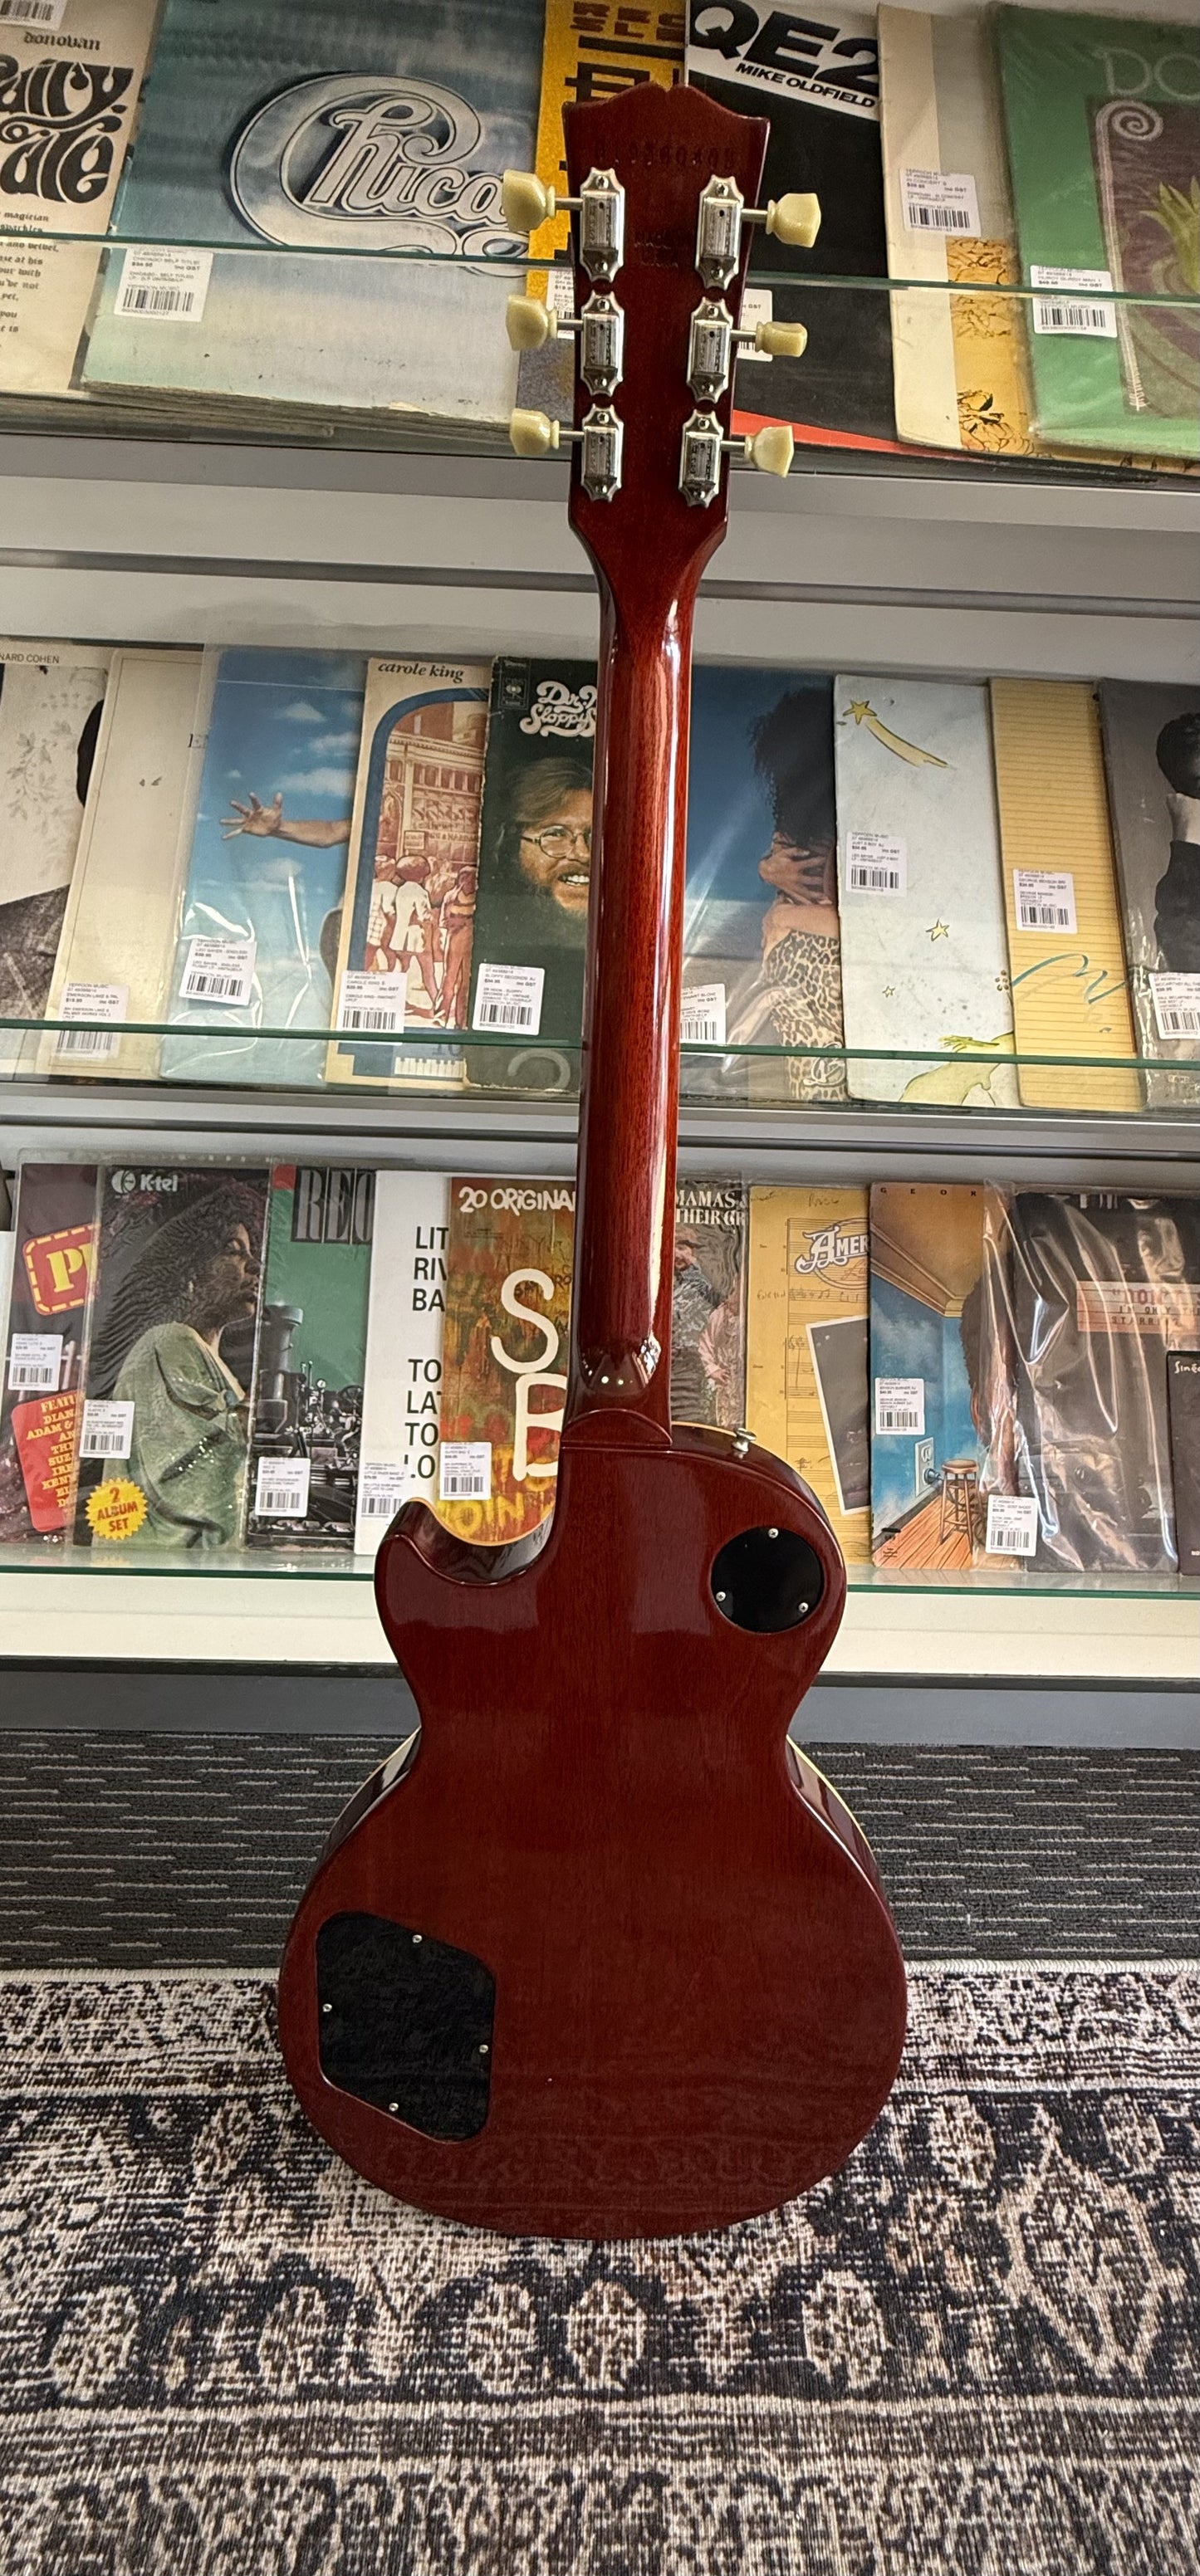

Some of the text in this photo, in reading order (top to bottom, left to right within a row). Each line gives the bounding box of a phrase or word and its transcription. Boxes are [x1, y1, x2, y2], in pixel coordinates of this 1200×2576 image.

[24, 32, 100, 51] donovan
[688, 0, 879, 98] QE2
[736, 62, 875, 109] MIKE OLDFIELD
[27, 653, 60, 663] COHEN
[378, 662, 465, 684] carole king
[140, 1172, 179, 1193] K-tel
[459, 1186, 487, 1213] 20
[415, 1226, 449, 1250] LIT
[412, 1288, 445, 1312] BA
[491, 1268, 560, 1374] S
[408, 1358, 443, 1383] TO
[406, 1390, 442, 1415] LA
[27, 1422, 62, 1440] ADAM
[64, 1420, 74, 1430] &
[404, 1421, 438, 1446] TO
[110, 1486, 120, 1504] 2
[97, 1500, 138, 1521] ALBUM
[109, 1517, 129, 1532] SET
